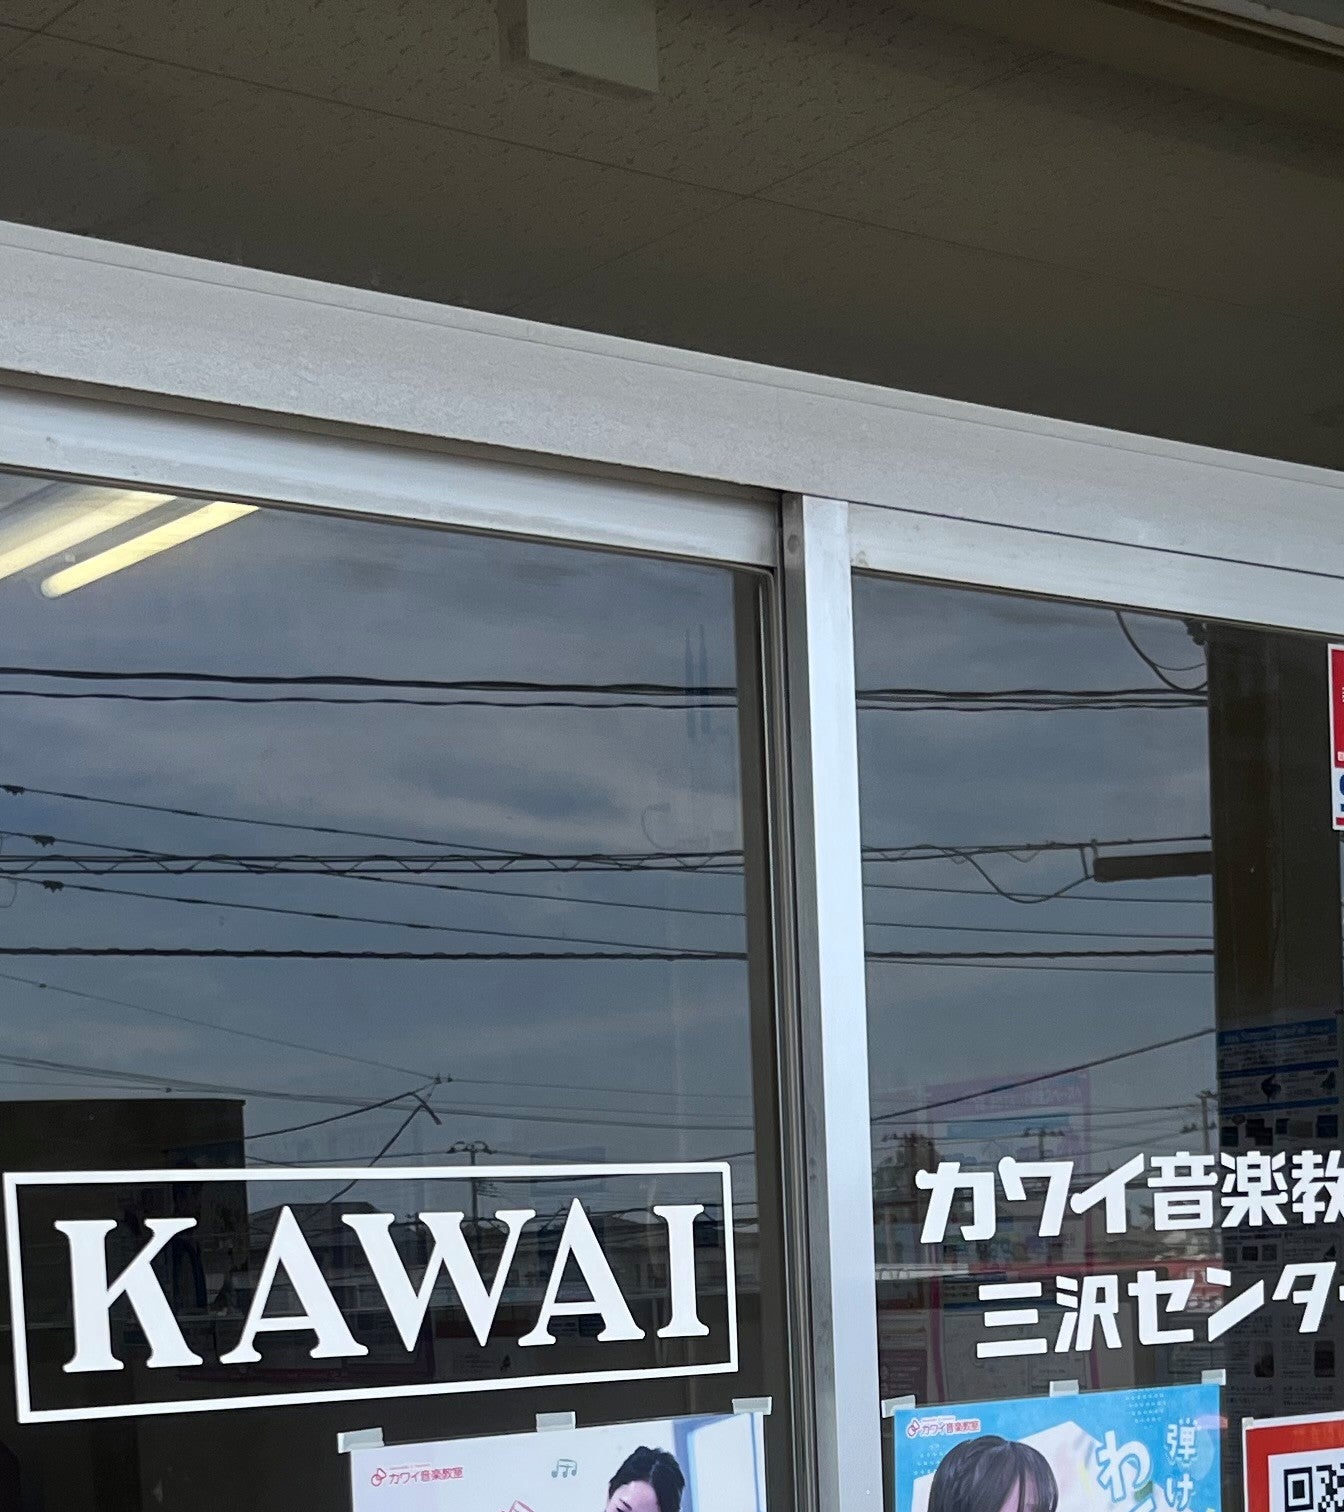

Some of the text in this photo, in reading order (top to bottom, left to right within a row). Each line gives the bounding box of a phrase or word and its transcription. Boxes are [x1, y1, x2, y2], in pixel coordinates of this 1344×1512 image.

[55, 1198, 710, 1372] KAWAI
[389, 1467, 463, 1484] カワイ音楽教室
